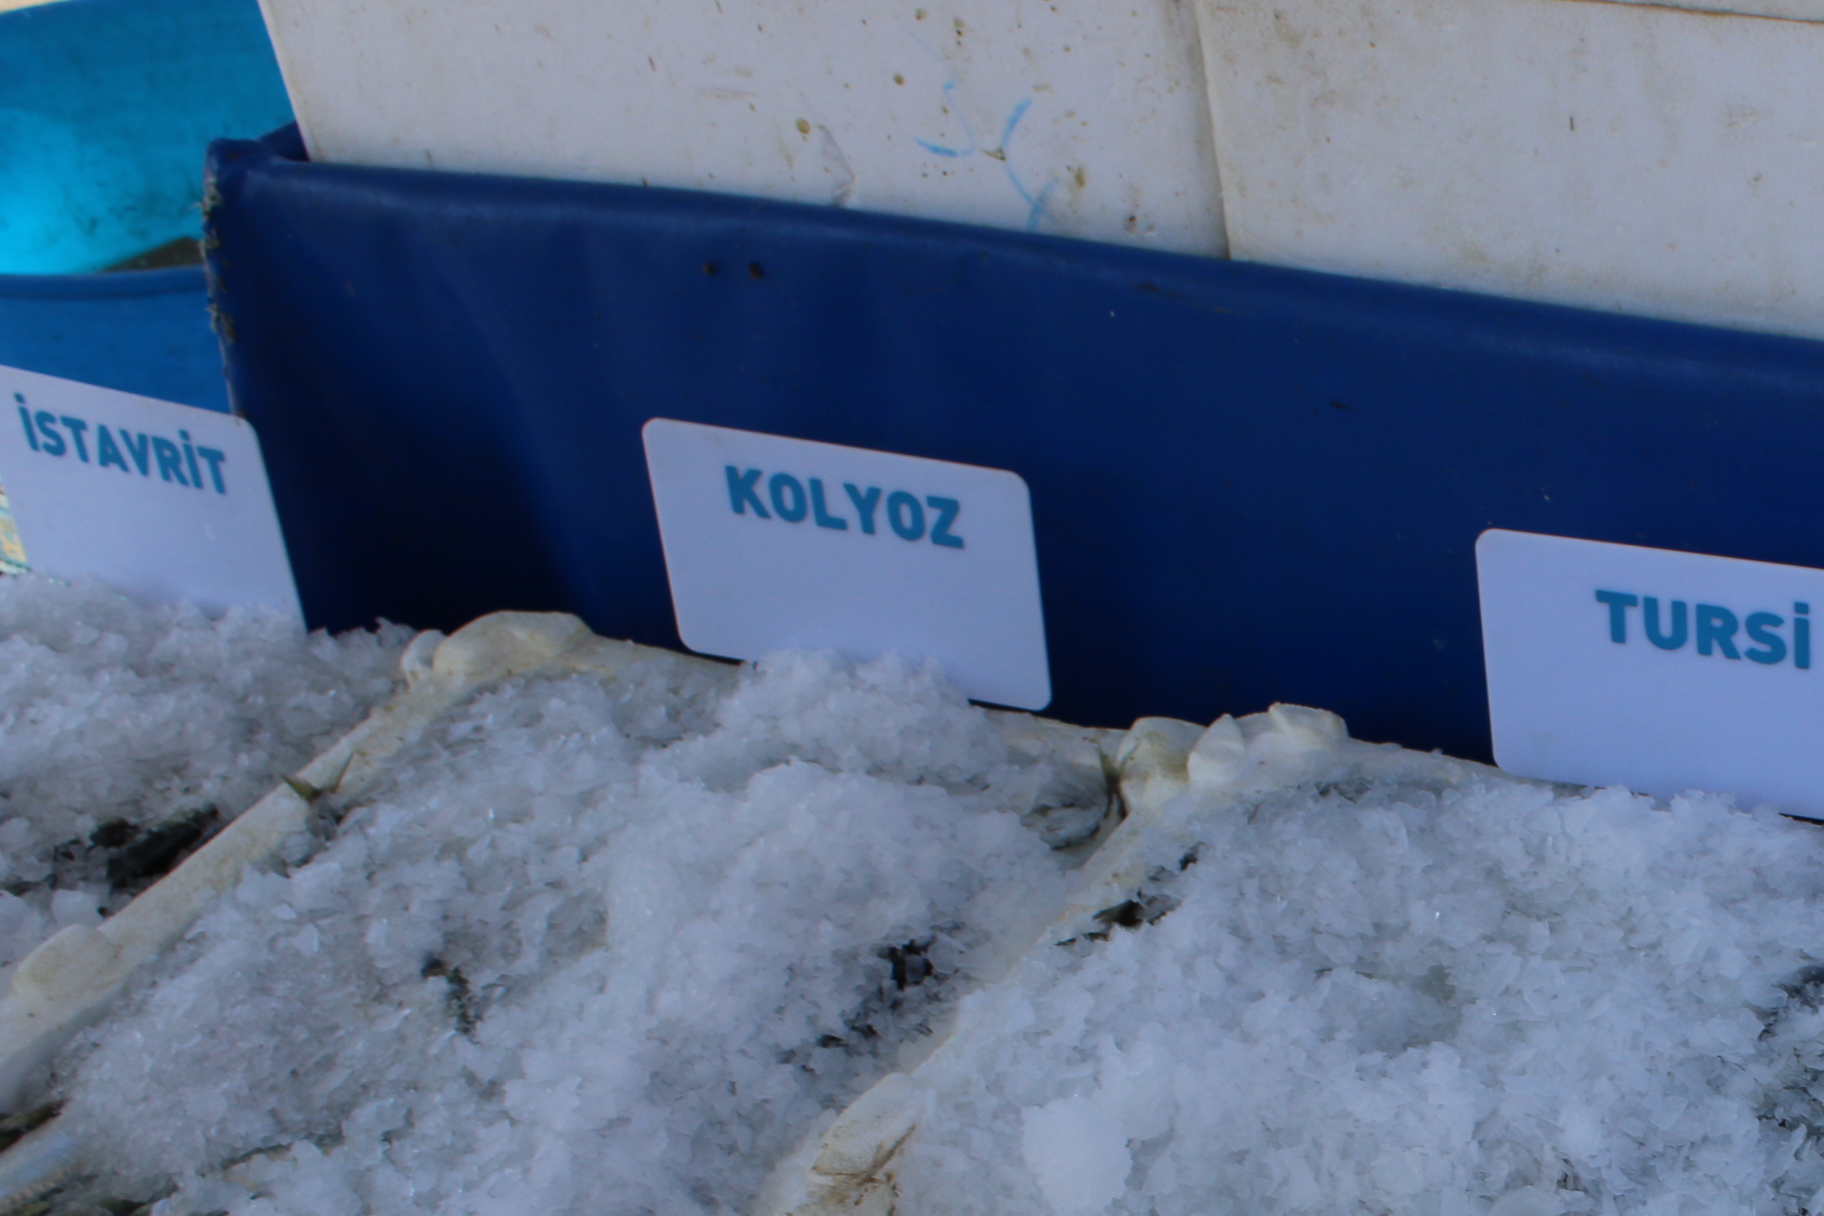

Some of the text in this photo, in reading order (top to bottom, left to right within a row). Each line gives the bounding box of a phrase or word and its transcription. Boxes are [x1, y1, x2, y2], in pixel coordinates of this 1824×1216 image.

[14, 392, 226, 495] İSTAVRİT
[724, 465, 965, 549] KOLYOZ
[1595, 588, 1811, 670] TURSİ
